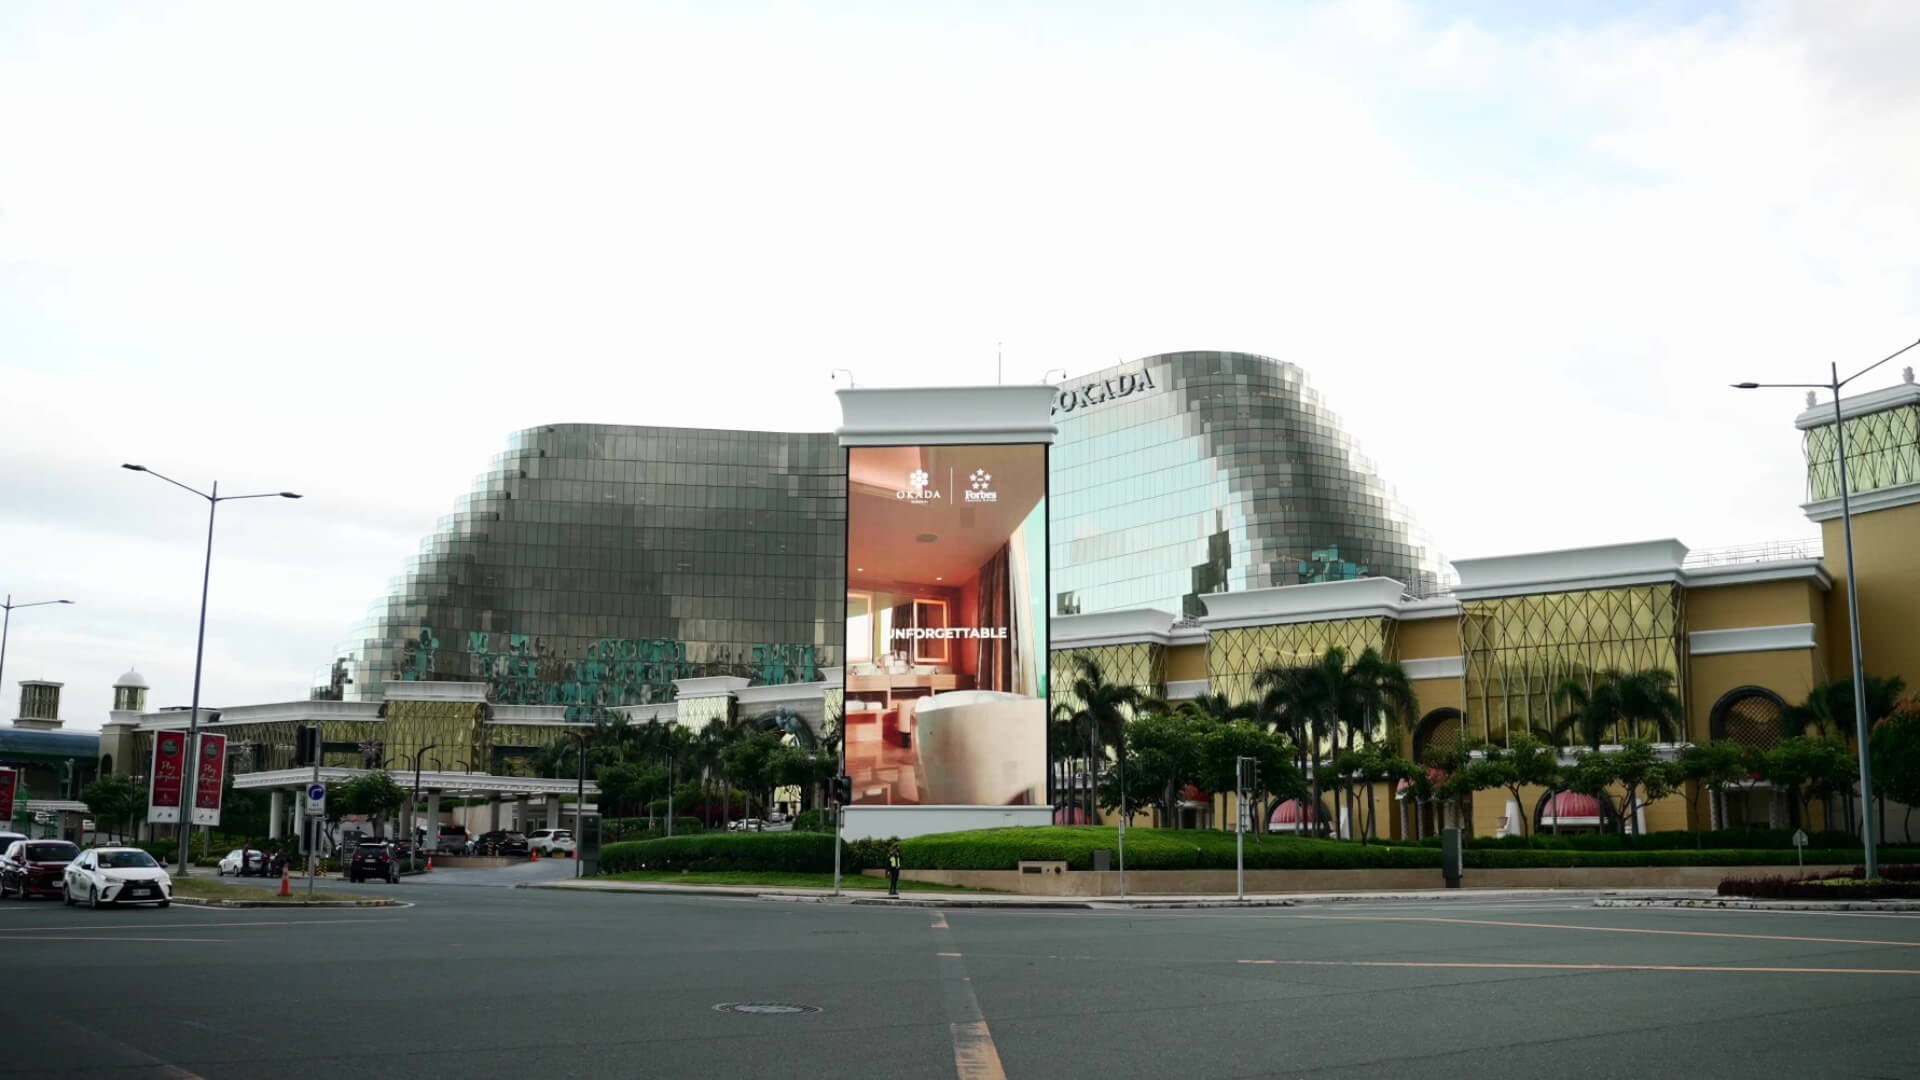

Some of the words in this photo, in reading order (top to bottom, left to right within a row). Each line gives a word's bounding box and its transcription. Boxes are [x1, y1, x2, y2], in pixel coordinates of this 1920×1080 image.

[1059, 367, 1156, 413] OKADA
[896, 490, 941, 499] OKADA
[965, 490, 997, 499] Forbes
